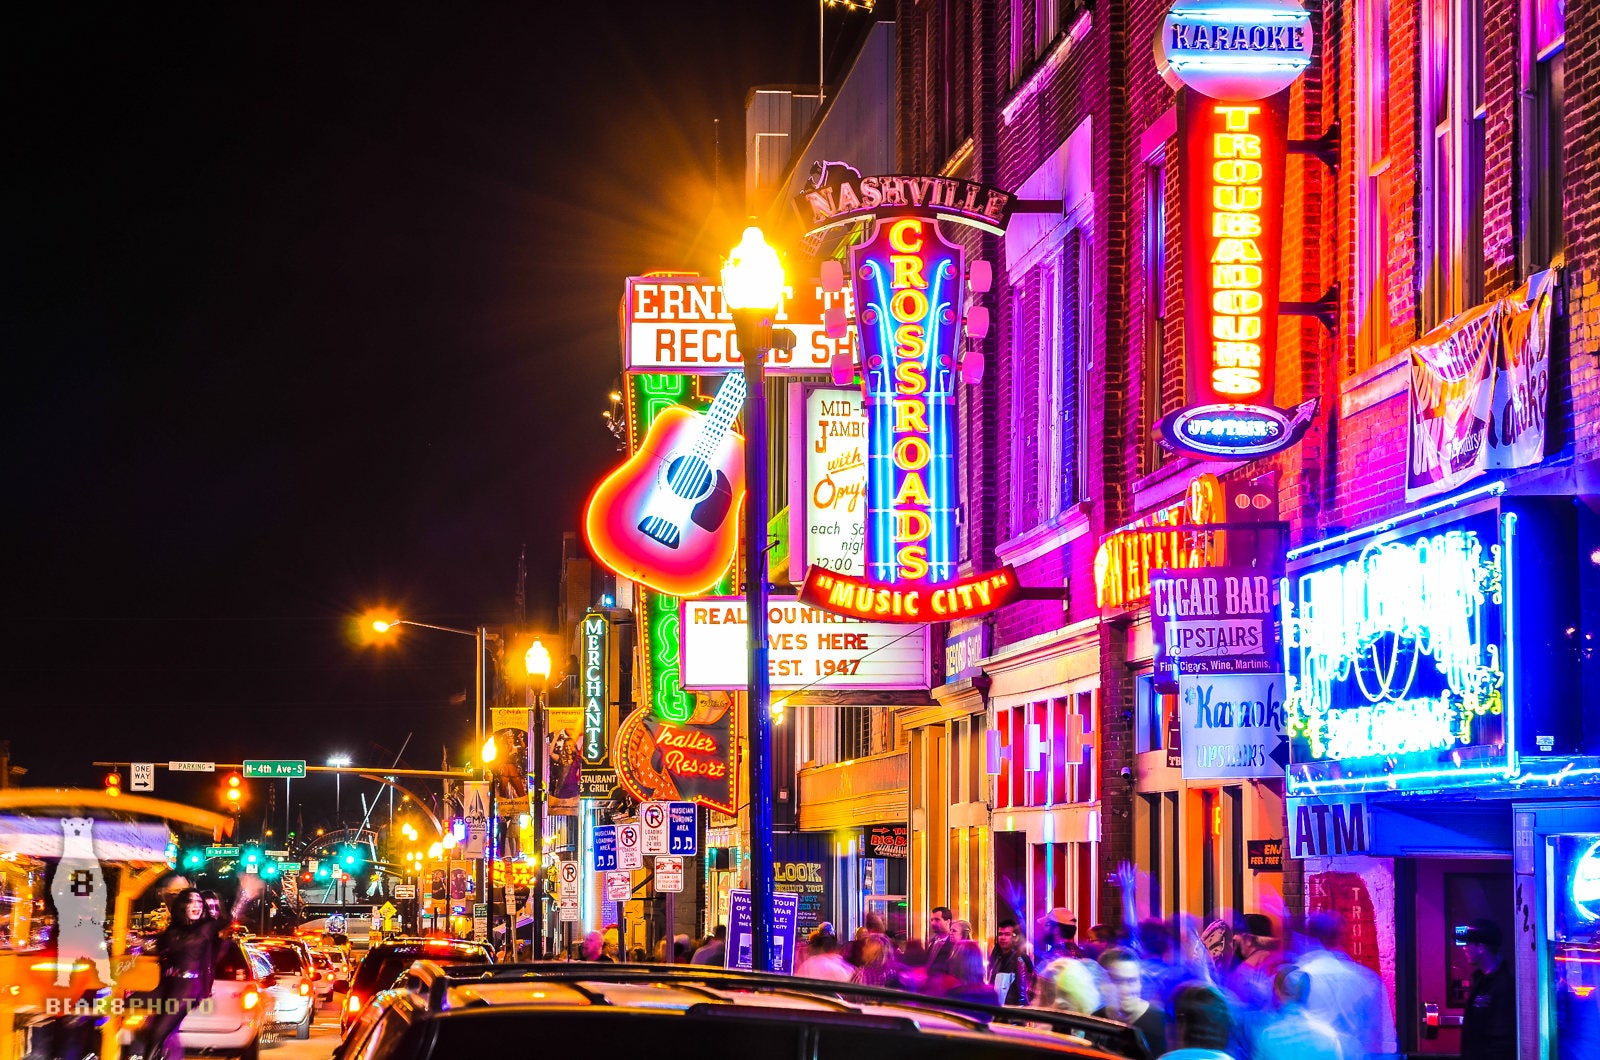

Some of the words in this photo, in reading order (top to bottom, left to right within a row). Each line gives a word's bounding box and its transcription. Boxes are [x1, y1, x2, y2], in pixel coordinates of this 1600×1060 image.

[1171, 24, 1304, 51] KARAOKE
[806, 175, 1008, 223] NASHVILLE
[1211, 106, 1263, 394] TROUBADOURS
[634, 284, 793, 320] ERNT
[888, 219, 932, 580] CROSSROADS
[827, 447, 861, 471] with
[811, 522, 840, 535] each
[1155, 577, 1219, 617] CIGAR
[1225, 575, 1270, 614] BAR
[694, 607, 748, 625] REAL
[817, 633, 868, 650] HERE
[1169, 625, 1259, 649] UPSTAIRS
[816, 659, 861, 676] 1947
[1210, 659, 1234, 670] Wine,
[585, 620, 603, 759] MERCHANTS
[656, 723, 717, 752] Trailer
[665, 751, 726, 777] Resort
[1197, 744, 1265, 767] UPSTAIRS
[589, 784, 610, 793] GRILL
[464, 815, 488, 825] CMA
[1295, 802, 1365, 856] ATM
[871, 834, 895, 846] BIG
[773, 862, 822, 883] LOOK
[773, 899, 795, 907] TOUR
[773, 907, 792, 915] WAR
